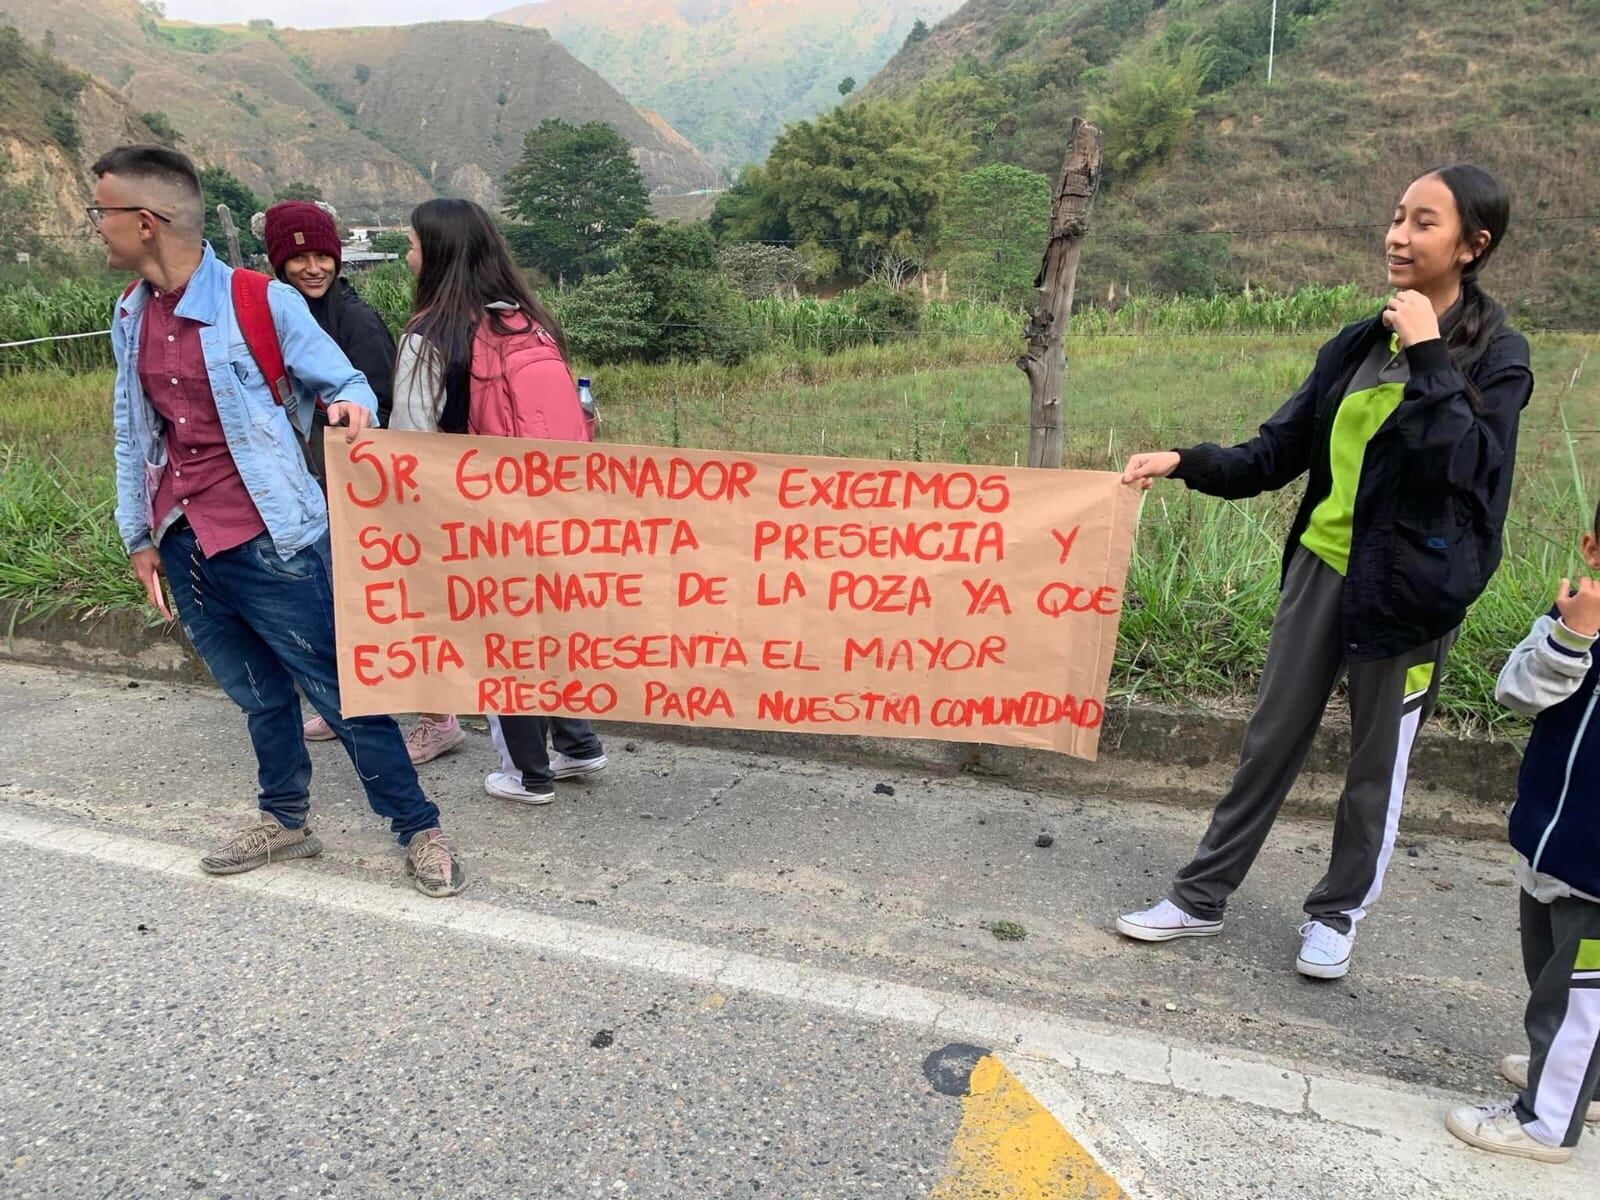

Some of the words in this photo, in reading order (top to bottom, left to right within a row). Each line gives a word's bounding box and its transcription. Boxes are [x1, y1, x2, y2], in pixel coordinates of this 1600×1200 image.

[455, 447, 758, 501] GOBERNADOR
[777, 467, 1010, 514] EXIGIMOS
[440, 517, 699, 564] INMEDIATA
[753, 520, 1004, 563] PRESENCIA
[1050, 527, 1080, 565] Y
[364, 577, 425, 625] EL
[446, 571, 642, 622] DRENAJE
[677, 571, 727, 608] DE
[757, 571, 807, 606] LA
[828, 570, 932, 615] POZA
[961, 577, 1012, 616] YA
[353, 634, 465, 687] ESTA
[483, 631, 748, 673] REPRESENTA
[762, 638, 820, 672] EL
[843, 635, 1008, 673] MAYOR
[478, 675, 618, 715] RIESGO
[644, 680, 734, 721] PARA
[757, 689, 921, 726] NUESTRA
[929, 690, 1104, 731] COMUNIDAD
